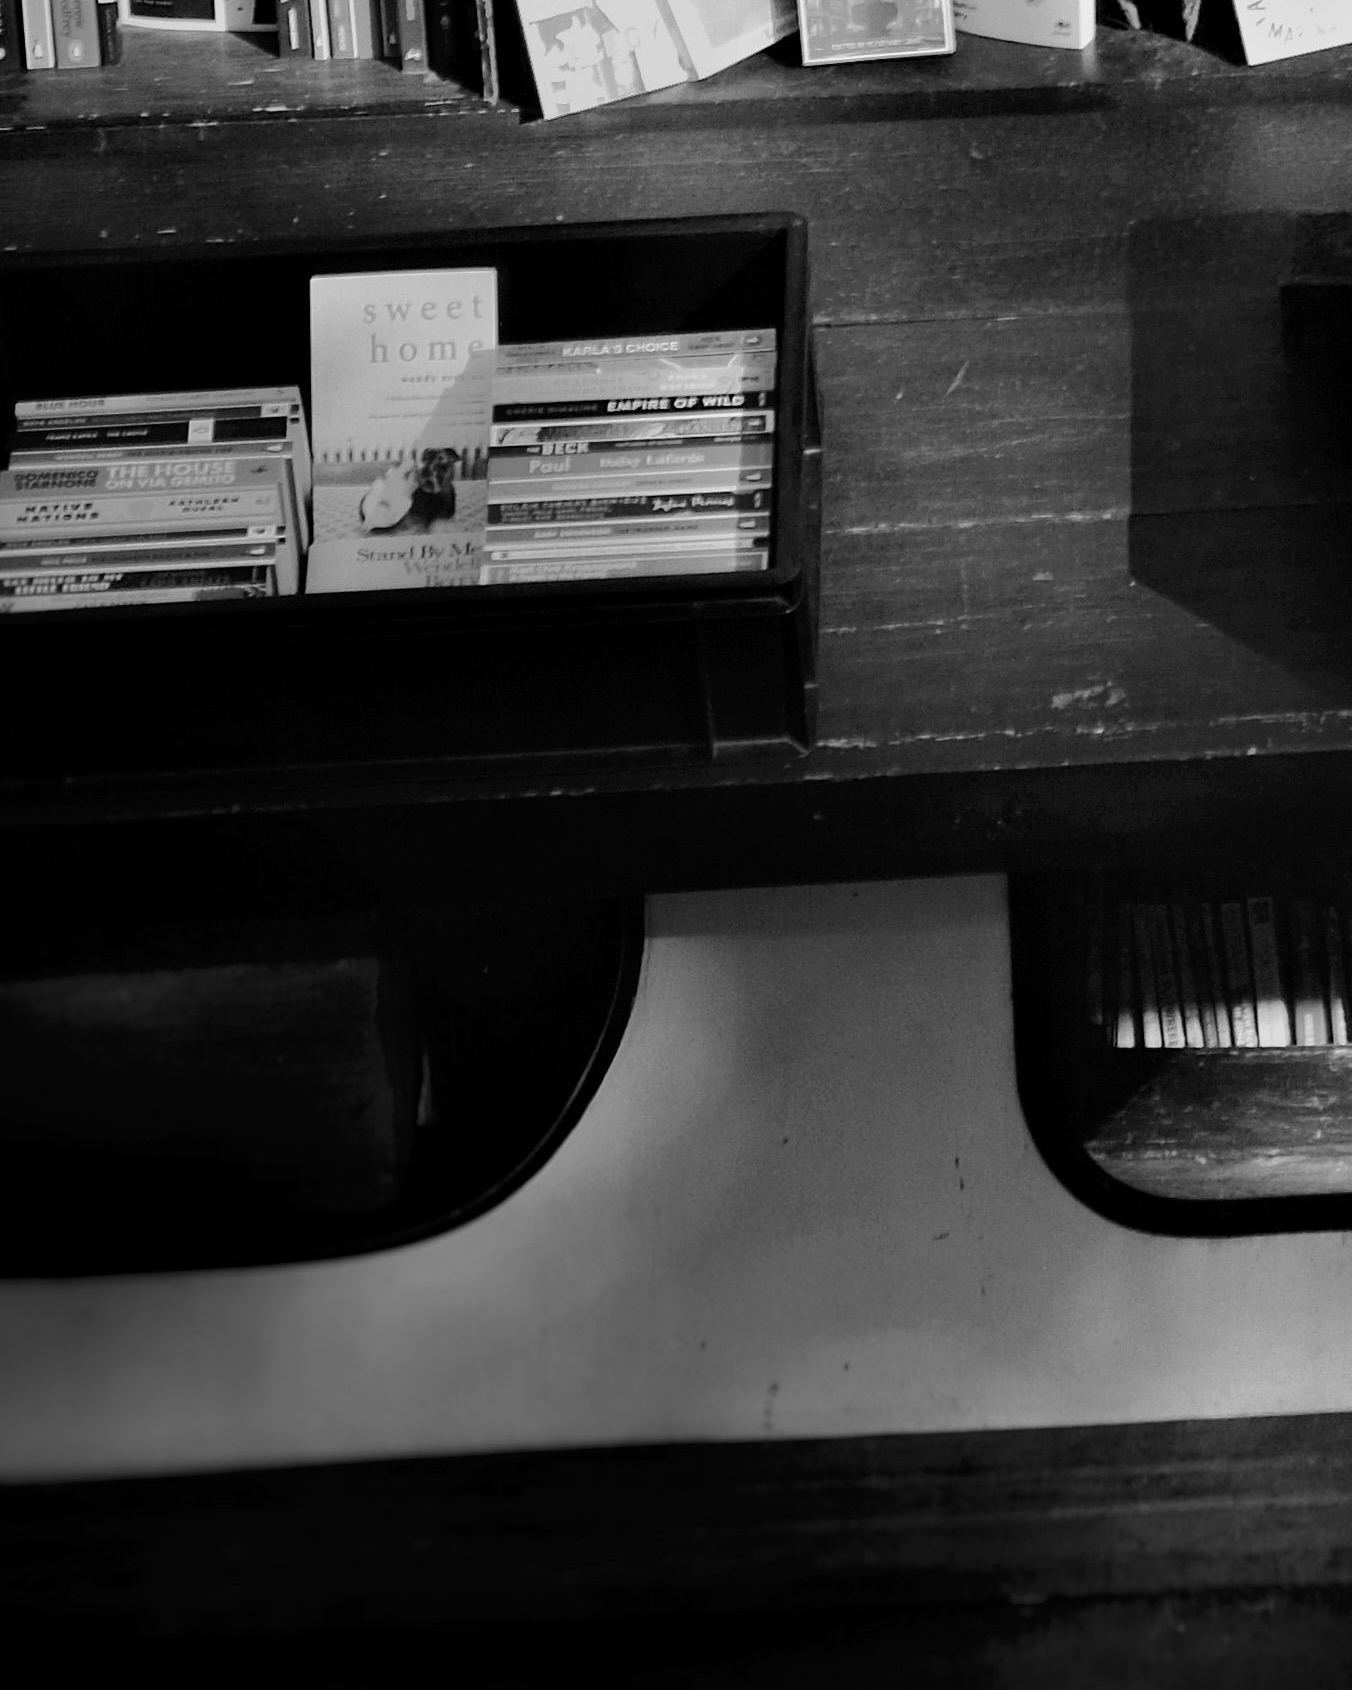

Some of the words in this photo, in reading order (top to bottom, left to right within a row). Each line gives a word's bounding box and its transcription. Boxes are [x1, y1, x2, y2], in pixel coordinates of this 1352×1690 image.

[361, 294, 484, 324] sweet
[368, 334, 485, 365] home
[562, 342, 622, 358] KARLA'S
[625, 340, 680, 354] CHOICE
[606, 397, 671, 413] EMPIRE
[672, 396, 698, 410] OF
[702, 394, 745, 408] WILD
[106, 463, 149, 480] THE
[153, 459, 237, 477] HOUSE
[529, 458, 572, 475] Paul
[104, 477, 135, 491] ON
[137, 475, 166, 489] VIA
[355, 543, 414, 563] Stand
[420, 543, 447, 564] By
[451, 541, 482, 557] Me
